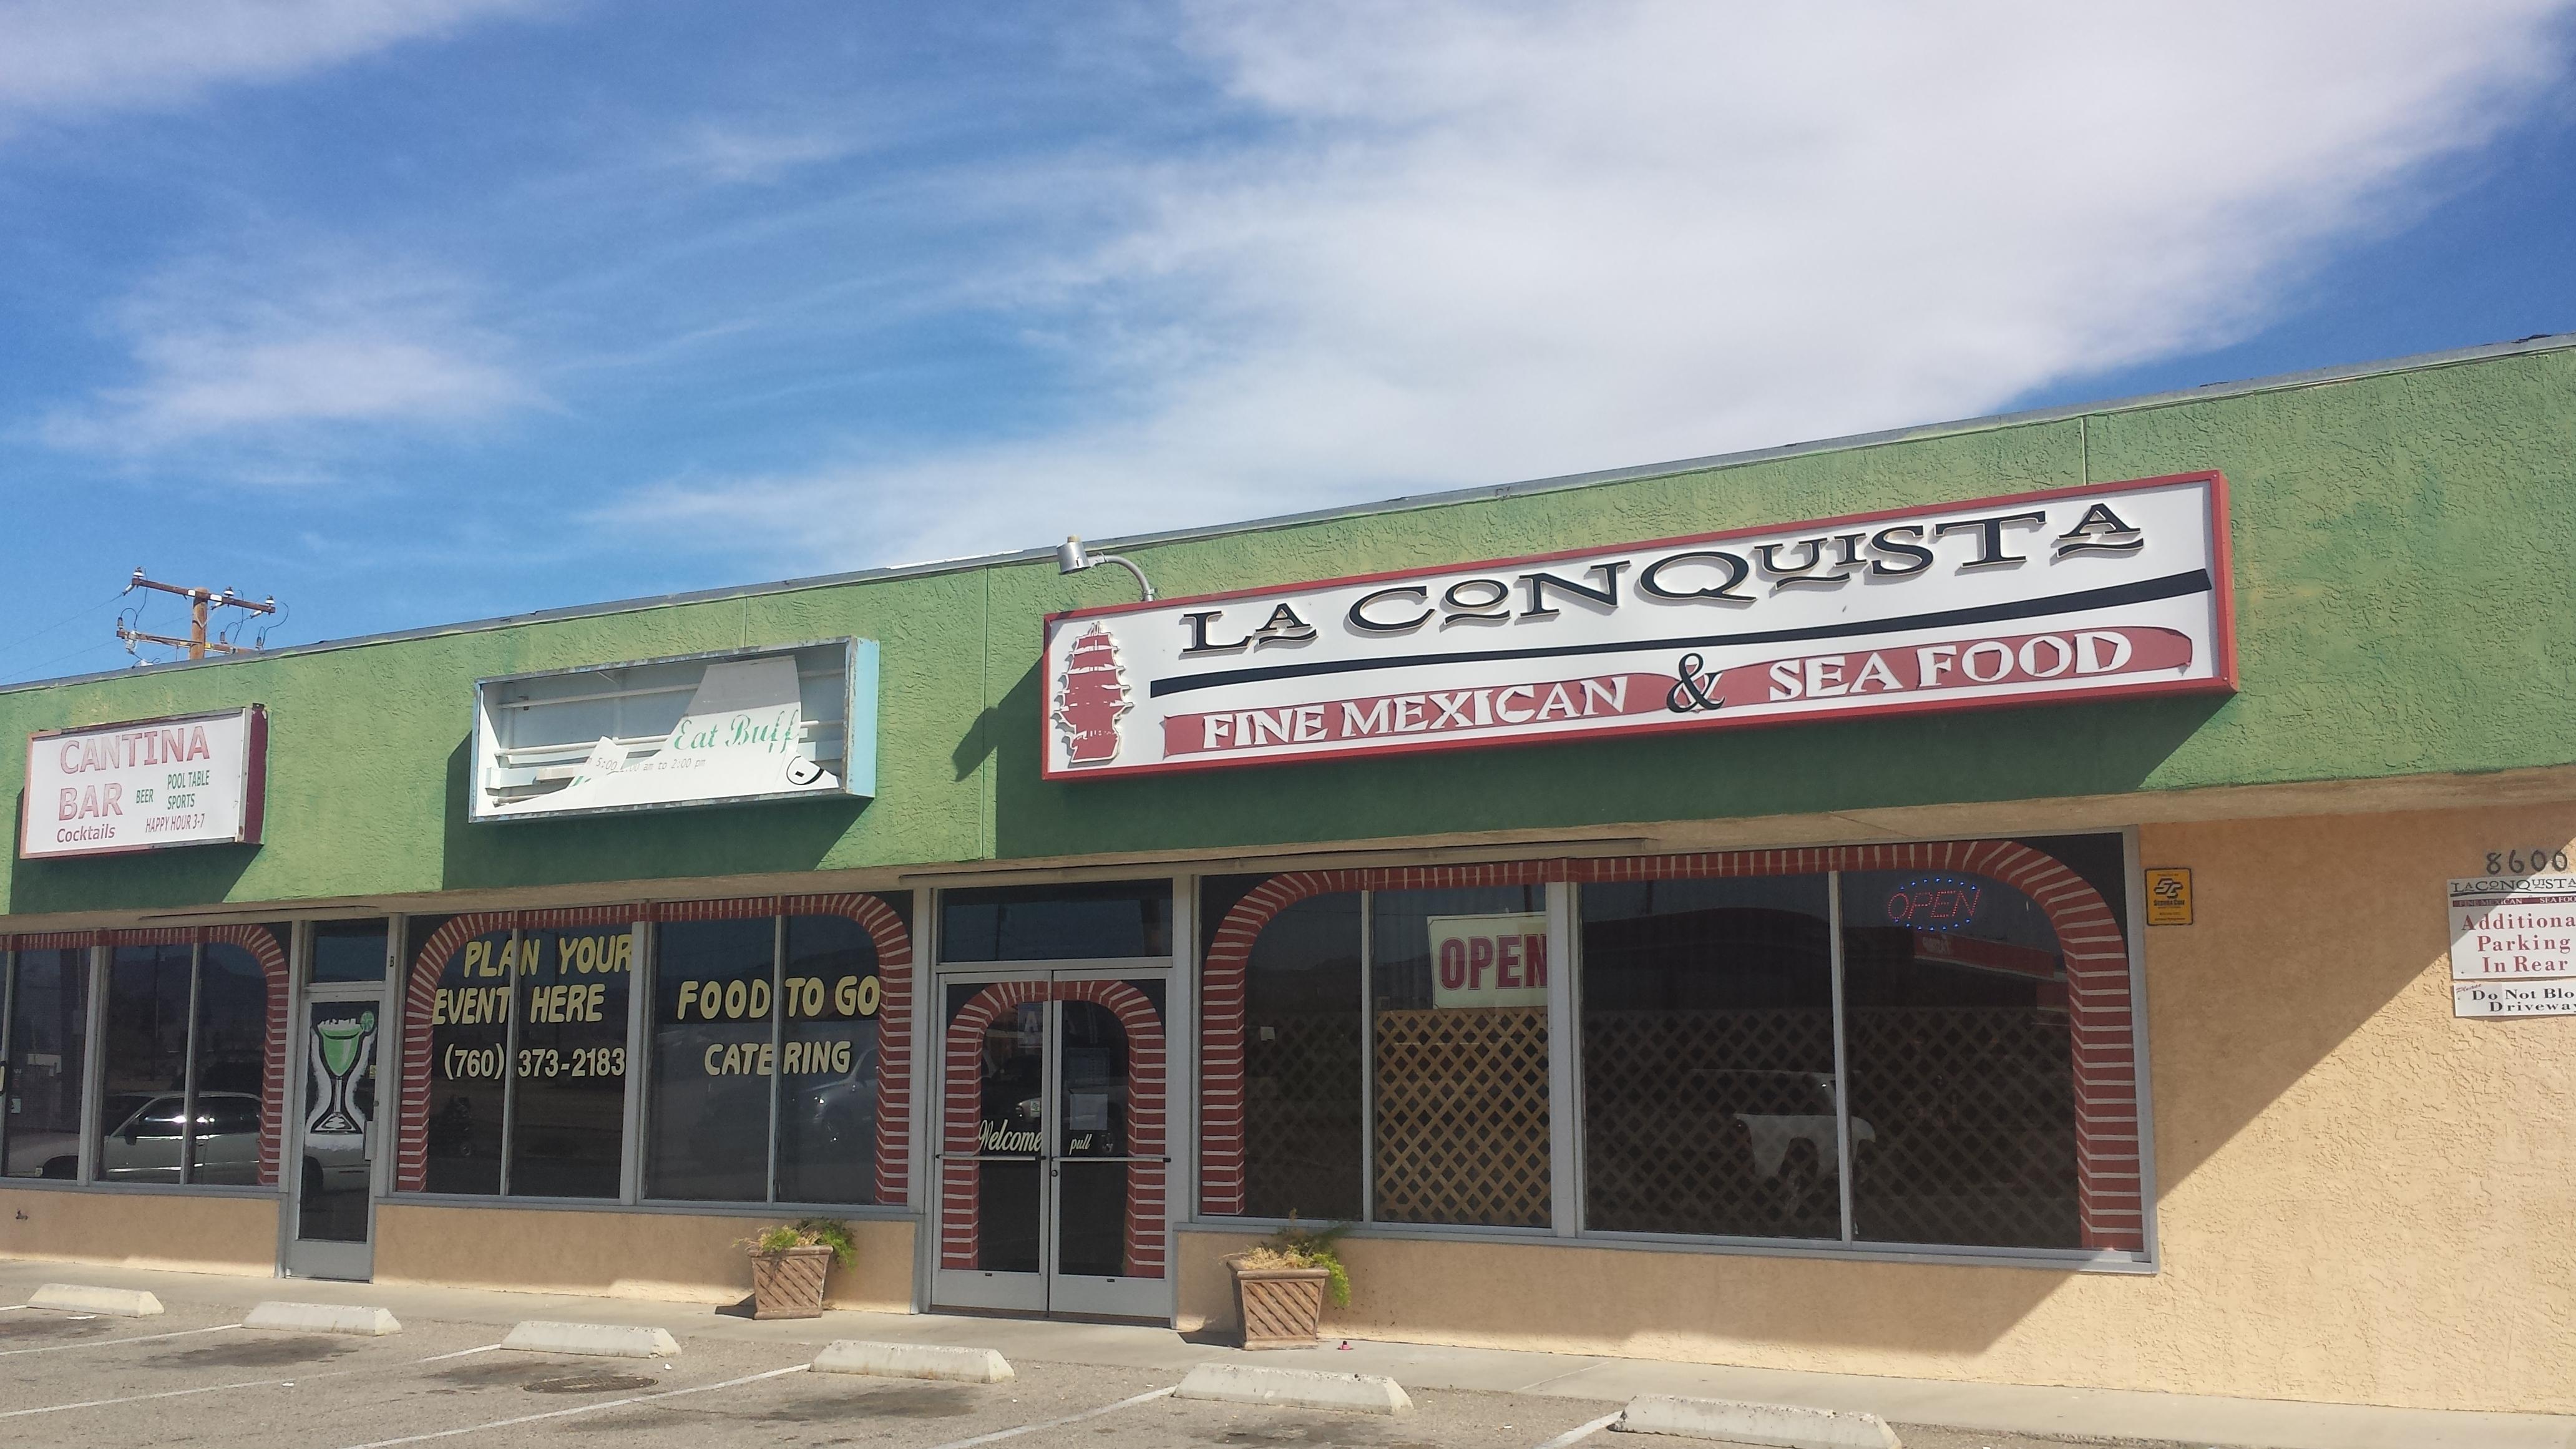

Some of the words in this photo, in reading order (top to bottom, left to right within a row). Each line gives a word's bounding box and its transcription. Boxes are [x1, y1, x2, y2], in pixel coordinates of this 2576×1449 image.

[1183, 603, 1318, 653] LA
[1348, 503, 2145, 632] CONQUISTA
[1203, 704, 1329, 750] FINE
[1340, 676, 1629, 738] MEXICAN
[1666, 653, 1725, 713] &
[60, 726, 210, 774] CANTINA
[674, 720, 718, 750] Eat
[658, 761, 668, 769] to
[671, 758, 691, 769] 2:00
[167, 772, 187, 790] POOL
[188, 769, 210, 787] TABLE
[58, 783, 123, 821] BAR
[135, 789, 154, 804] BEER
[167, 793, 195, 810] SPORTS
[56, 824, 115, 843] Cocktails
[145, 816, 168, 834] HAPPY
[170, 815, 191, 831] HOUR
[193, 813, 205, 829] 3-7
[2486, 849, 2568, 874] 8600
[1888, 889, 1981, 919] OPEN
[464, 937, 541, 978] PLAN
[559, 934, 633, 975] YOUR
[2477, 934, 2570, 954] Parking
[1440, 934, 1548, 990] OPEN
[2482, 957, 2506, 973] In
[2514, 955, 2568, 972] Rear
[432, 986, 512, 1025] EVENT
[529, 983, 606, 1023] HERE
[677, 978, 772, 1020] FOOD
[785, 977, 826, 1017] TO
[835, 975, 881, 1017] GO
[2472, 990, 2497, 1000] Do
[2505, 989, 2535, 1000] Not
[444, 1043, 505, 1080] (760)
[517, 1048, 625, 1078] 373-2183
[978, 1119, 1042, 1152] Welcome
[1069, 1134, 1092, 1156] pull
